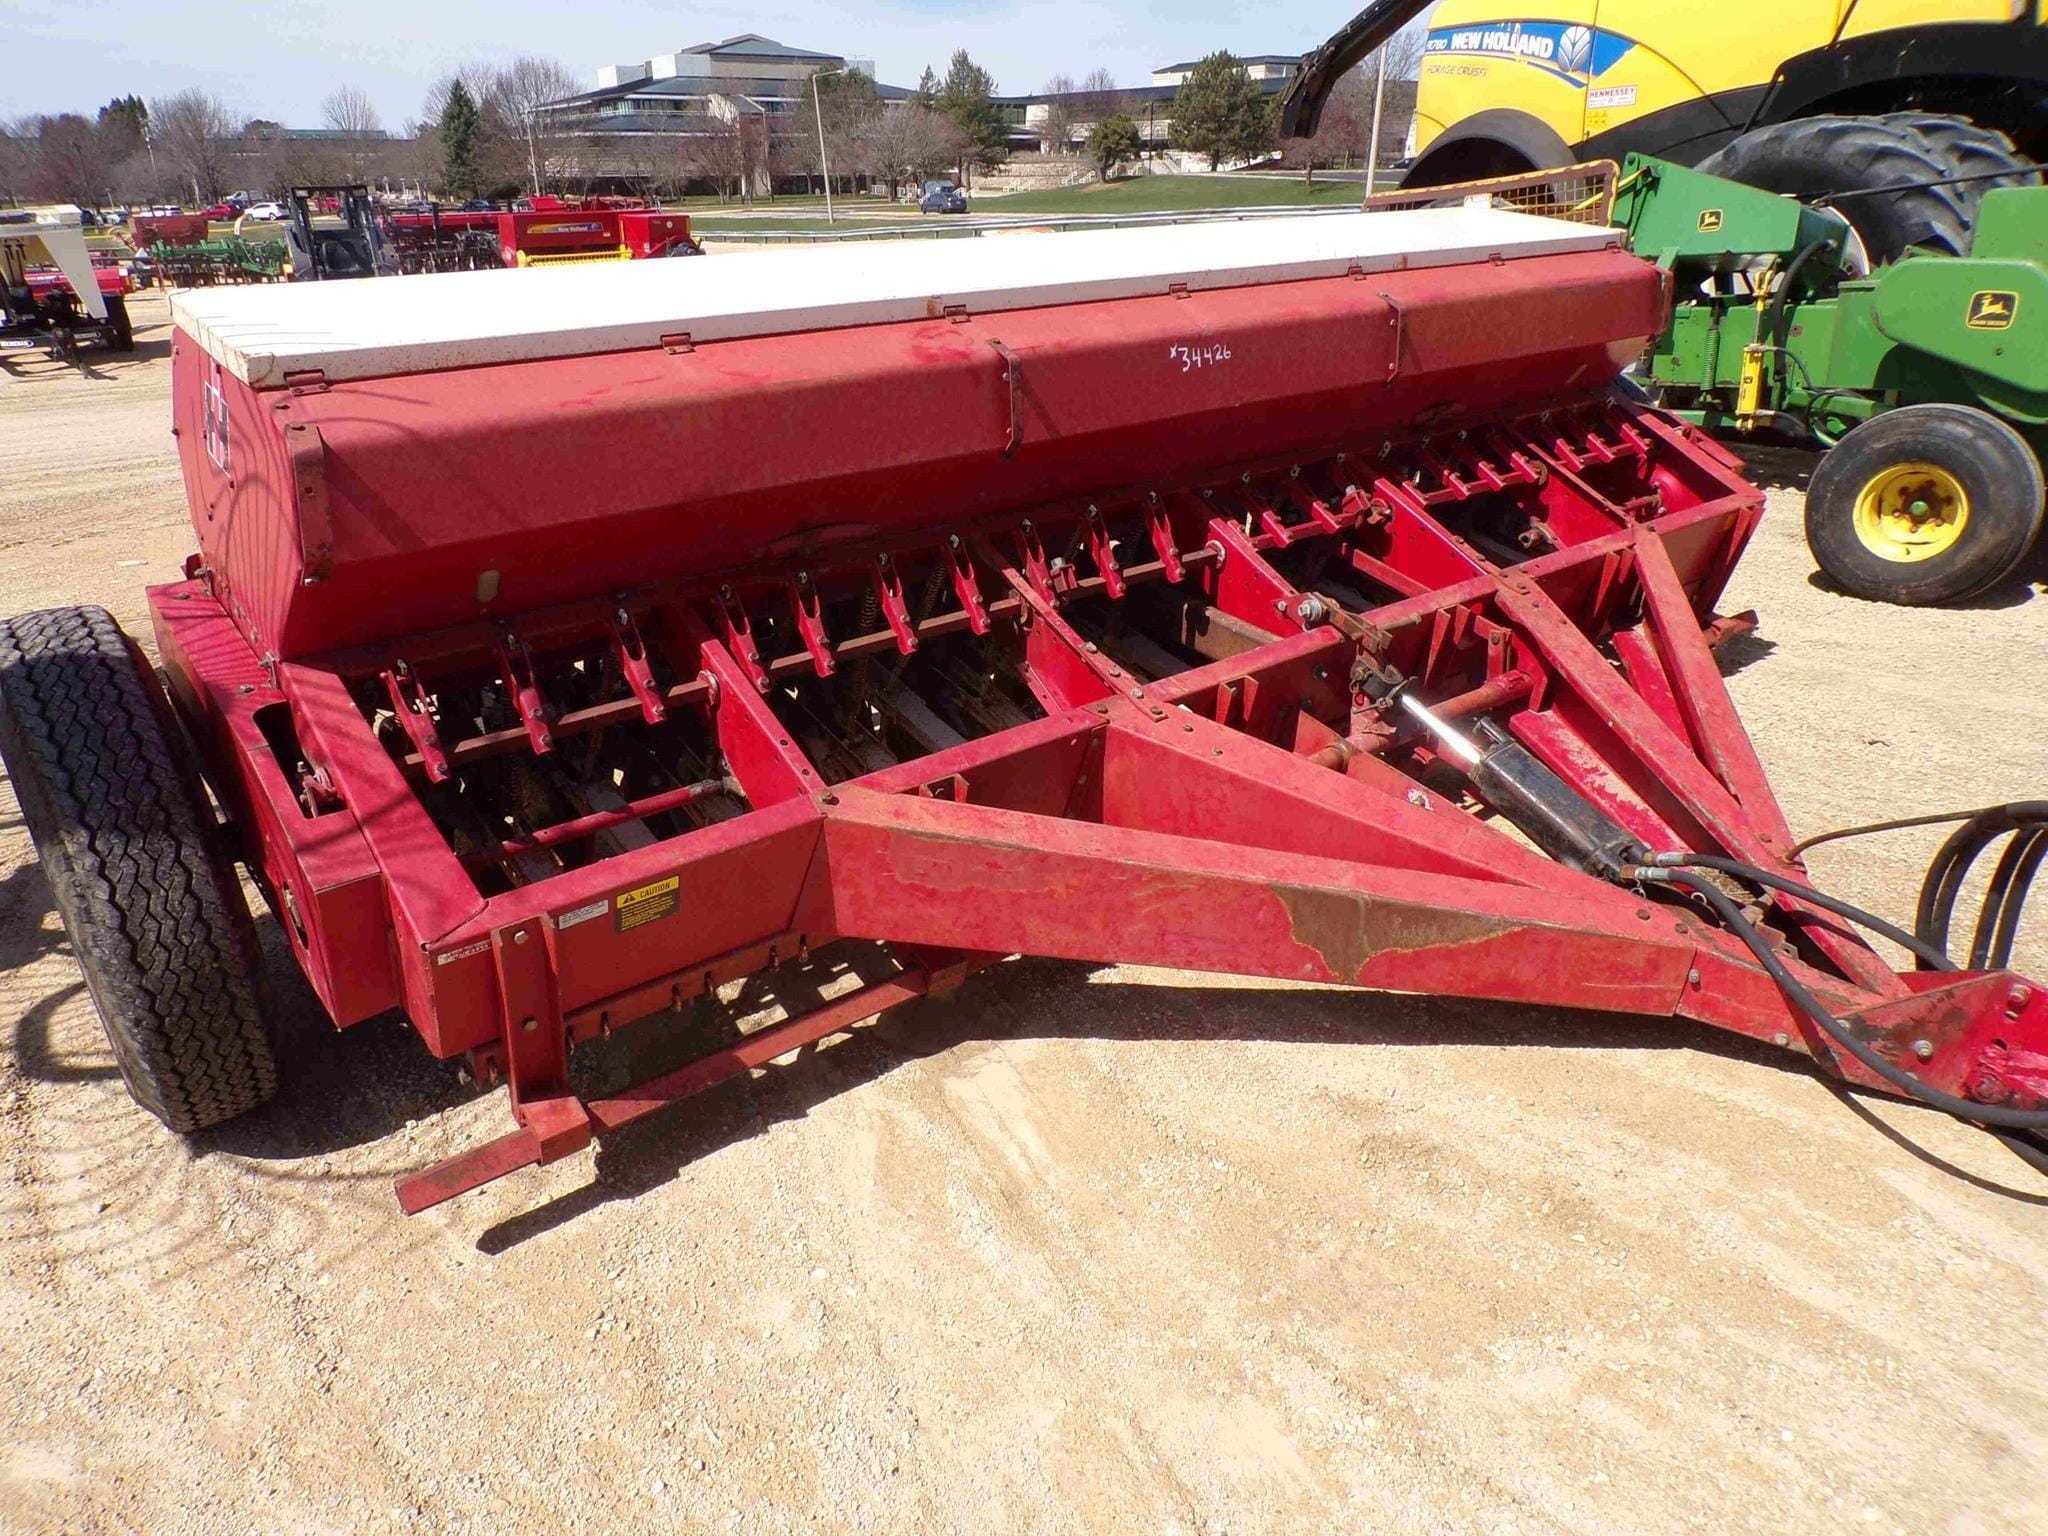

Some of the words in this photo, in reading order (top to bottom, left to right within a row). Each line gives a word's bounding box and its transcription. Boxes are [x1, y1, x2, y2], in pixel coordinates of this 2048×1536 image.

[1451, 31, 1482, 50] NEW
[1482, 32, 1554, 58] HOLLAND
[1590, 87, 1635, 98] HENNESSEY
[640, 881, 671, 899] CAUTION
